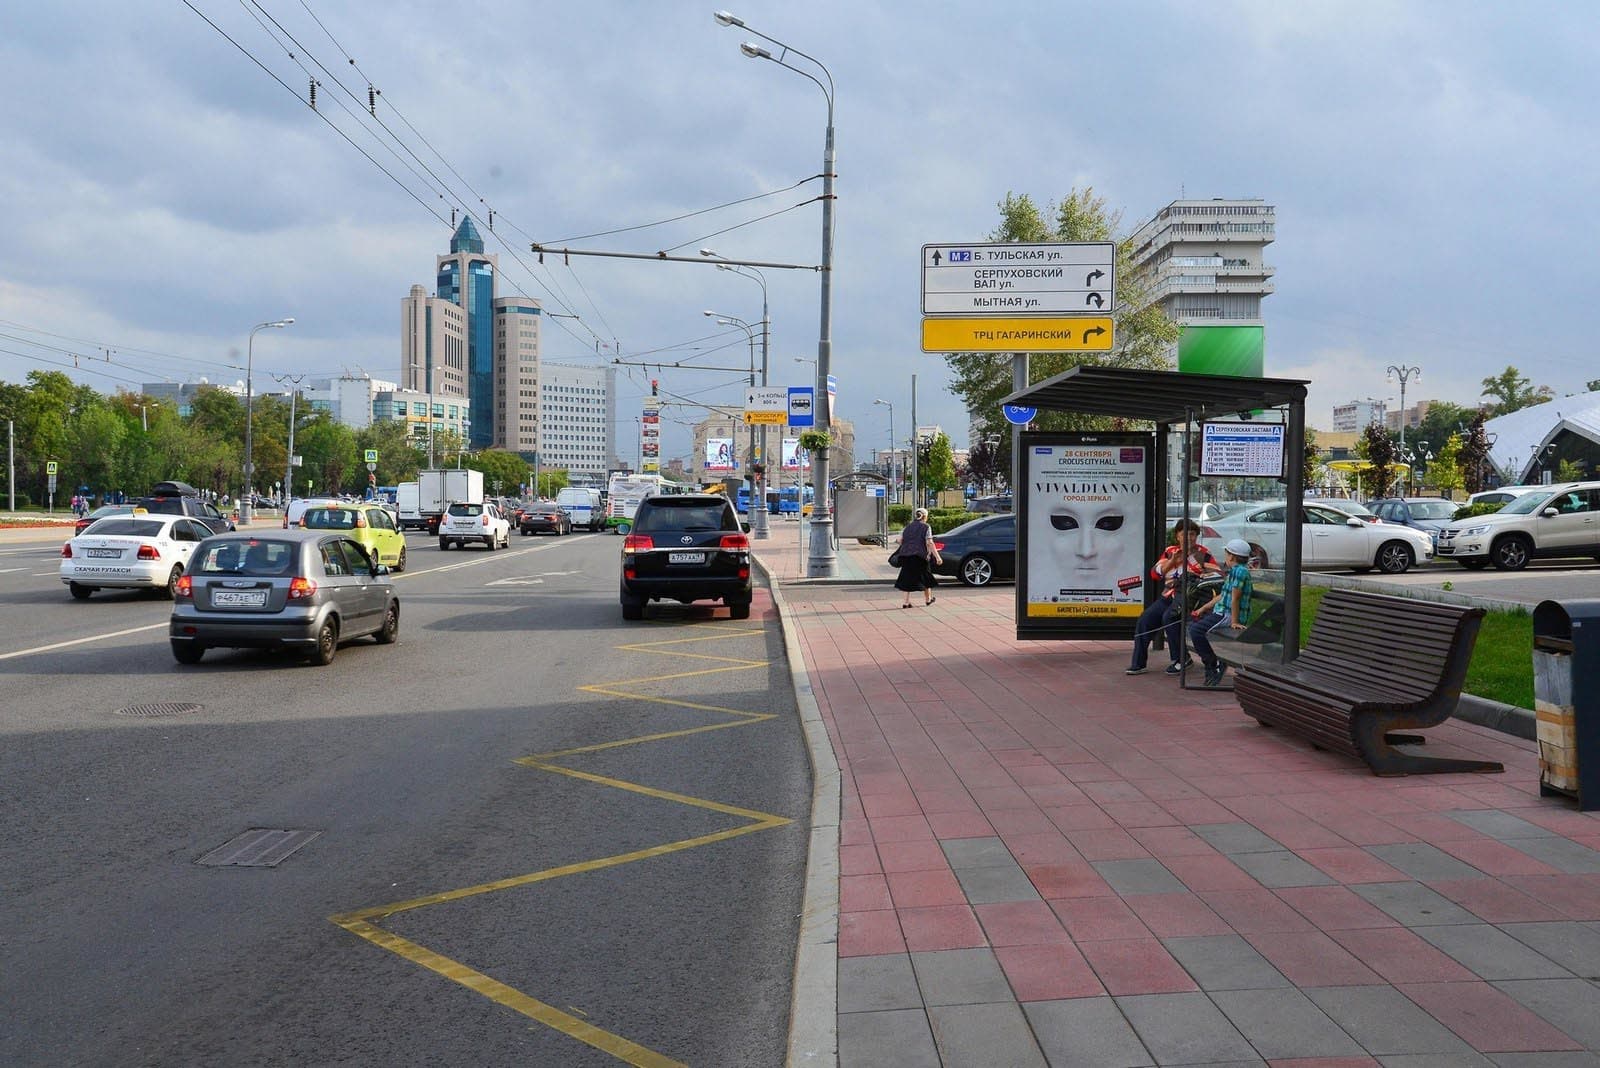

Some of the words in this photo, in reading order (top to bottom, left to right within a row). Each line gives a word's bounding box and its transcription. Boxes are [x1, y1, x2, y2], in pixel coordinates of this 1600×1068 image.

[974, 251, 985, 261] Б.
[987, 250, 1044, 260] ТУЛЬСКАЯ
[1047, 251, 1063, 262] ул.
[974, 268, 1063, 278] СЕРПУХОВСКИЙ
[974, 280, 996, 289] ВАЛ
[999, 281, 1015, 290] ул.
[973, 297, 1022, 307] МЫТНАЯ
[1025, 299, 1041, 308] ул.
[973, 331, 994, 341] ТРЦ
[996, 329, 1071, 340] ГАГАРИНСКИЙ
[1074, 450, 1112, 458] СЕНТЯБРЯ
